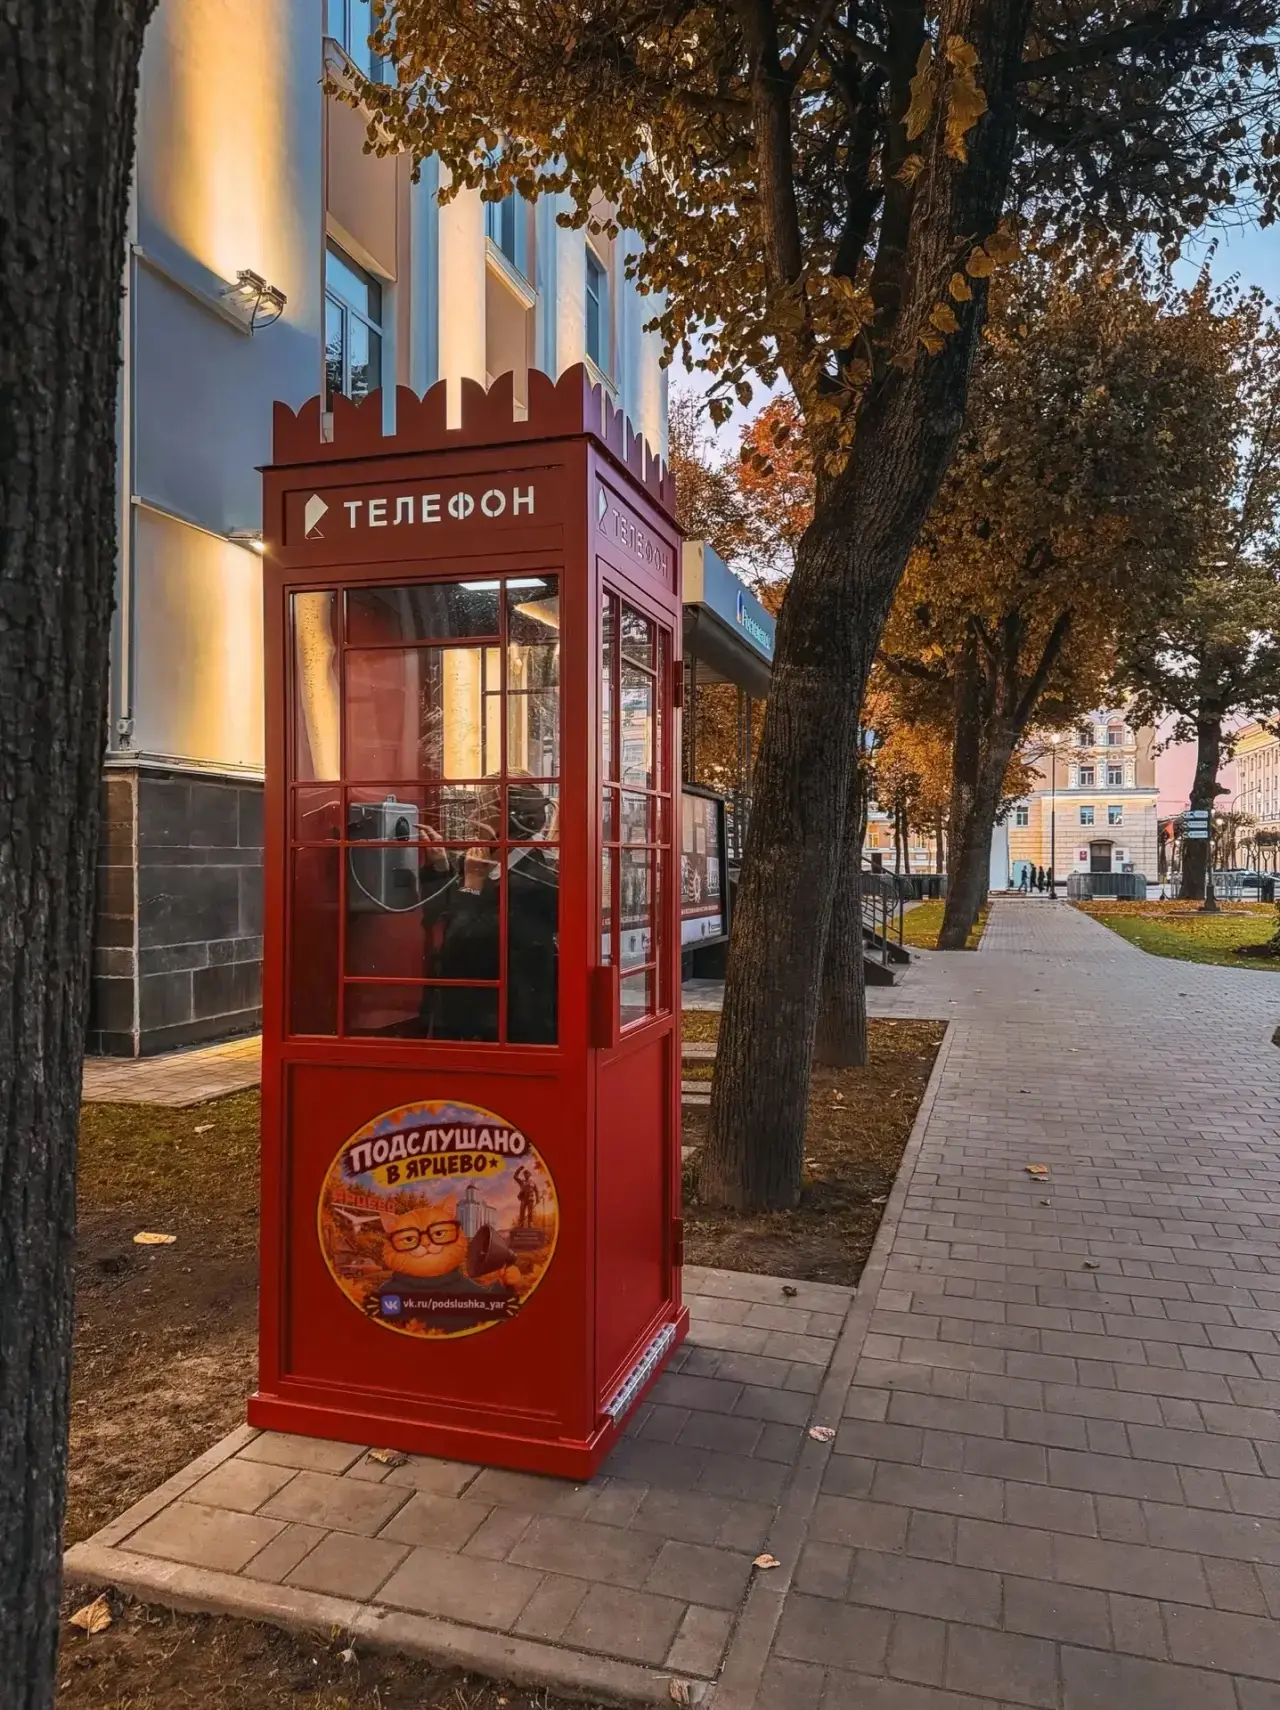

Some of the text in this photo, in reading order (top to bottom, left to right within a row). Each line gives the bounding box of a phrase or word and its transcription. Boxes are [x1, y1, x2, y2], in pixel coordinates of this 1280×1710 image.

[344, 486, 535, 528] ТЕЛЕФОН
[612, 508, 668, 578] ТЕЛЕФОН
[350, 1128, 526, 1172] ПОДСЛУШАНО
[386, 1154, 487, 1185] В ЯРЦЕВО
[403, 1298, 505, 1311] vk.ru/podslushka_yar
